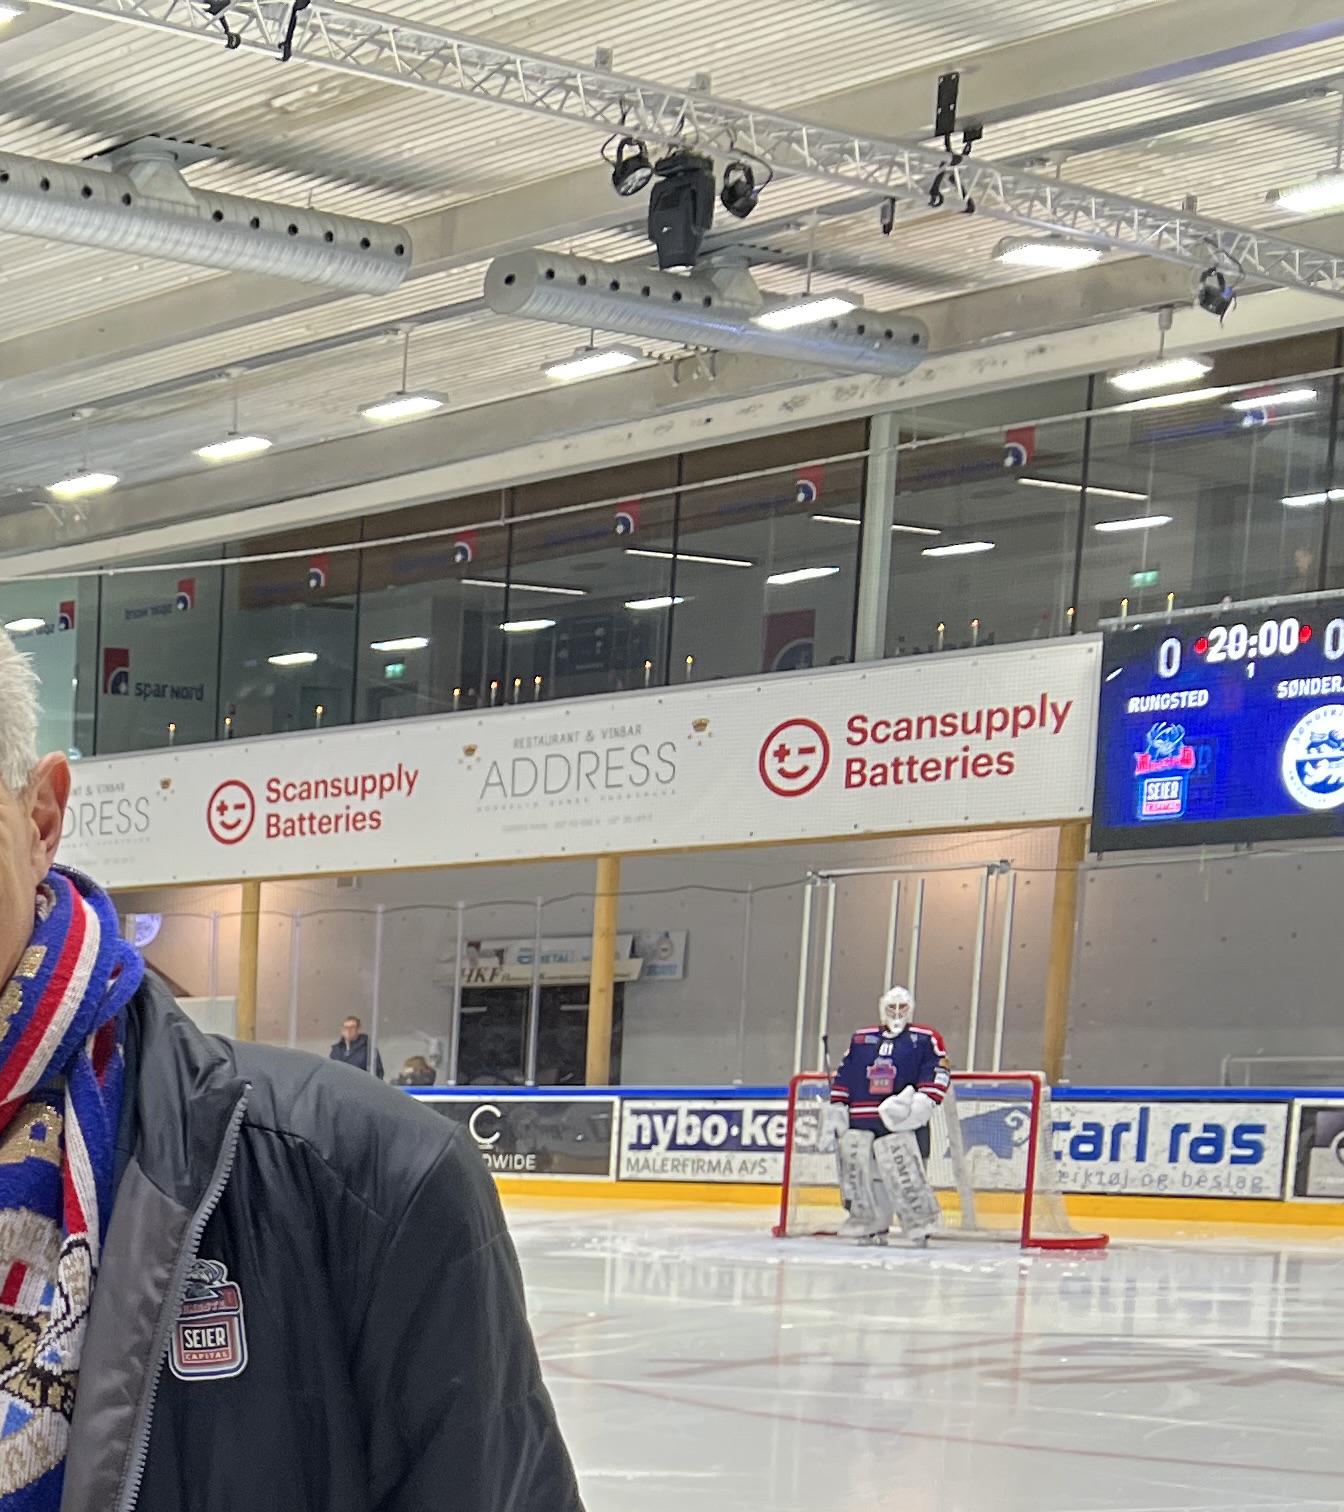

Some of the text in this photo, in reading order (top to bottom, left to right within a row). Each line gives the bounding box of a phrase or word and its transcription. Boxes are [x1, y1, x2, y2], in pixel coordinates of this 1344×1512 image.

[1157, 637, 1182, 679] 0
[1206, 618, 1300, 664] 20:00
[1126, 689, 1210, 714] RUNGSTED
[1276, 675, 1344, 700] SØNDER
[513, 724, 642, 750] RESTAURANT & VINBAR
[845, 693, 1073, 747] Scansupply
[265, 762, 419, 804] Scansupply
[480, 741, 677, 800] ADDRESS
[844, 744, 1015, 790] Batteries
[61, 796, 151, 840] DRESS
[265, 805, 382, 839] Batteries
[482, 1154, 537, 1171] DWIDE
[1168, 1122, 1266, 1165] ras
[625, 1156, 769, 1175] MALERFIRMA A/S
[1142, 1172, 1169, 1191] og
[184, 1327, 226, 1349] SEIER
